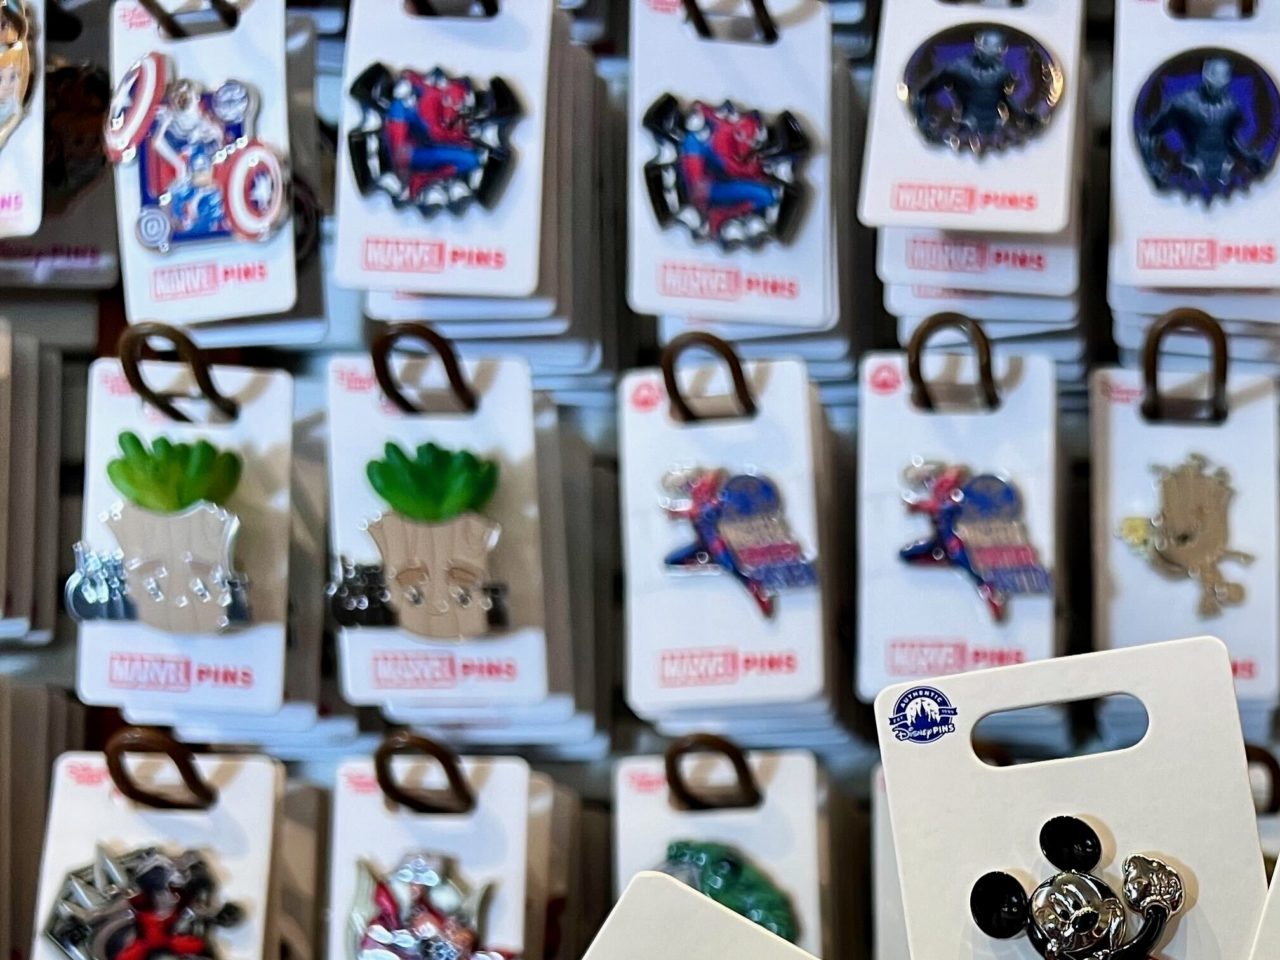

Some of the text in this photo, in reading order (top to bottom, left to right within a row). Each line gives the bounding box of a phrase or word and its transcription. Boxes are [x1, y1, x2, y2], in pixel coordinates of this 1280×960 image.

[979, 192, 1038, 211] PINS
[449, 249, 506, 270] PINS
[1220, 245, 1277, 263] PINS
[744, 276, 798, 298] PINS
[742, 653, 798, 674] PINS
[970, 648, 1025, 667] PINS
[196, 666, 254, 688] PINS
[460, 658, 518, 681] PINS
[900, 690, 942, 708] AUTHENTIC
[932, 723, 955, 735] PINS
